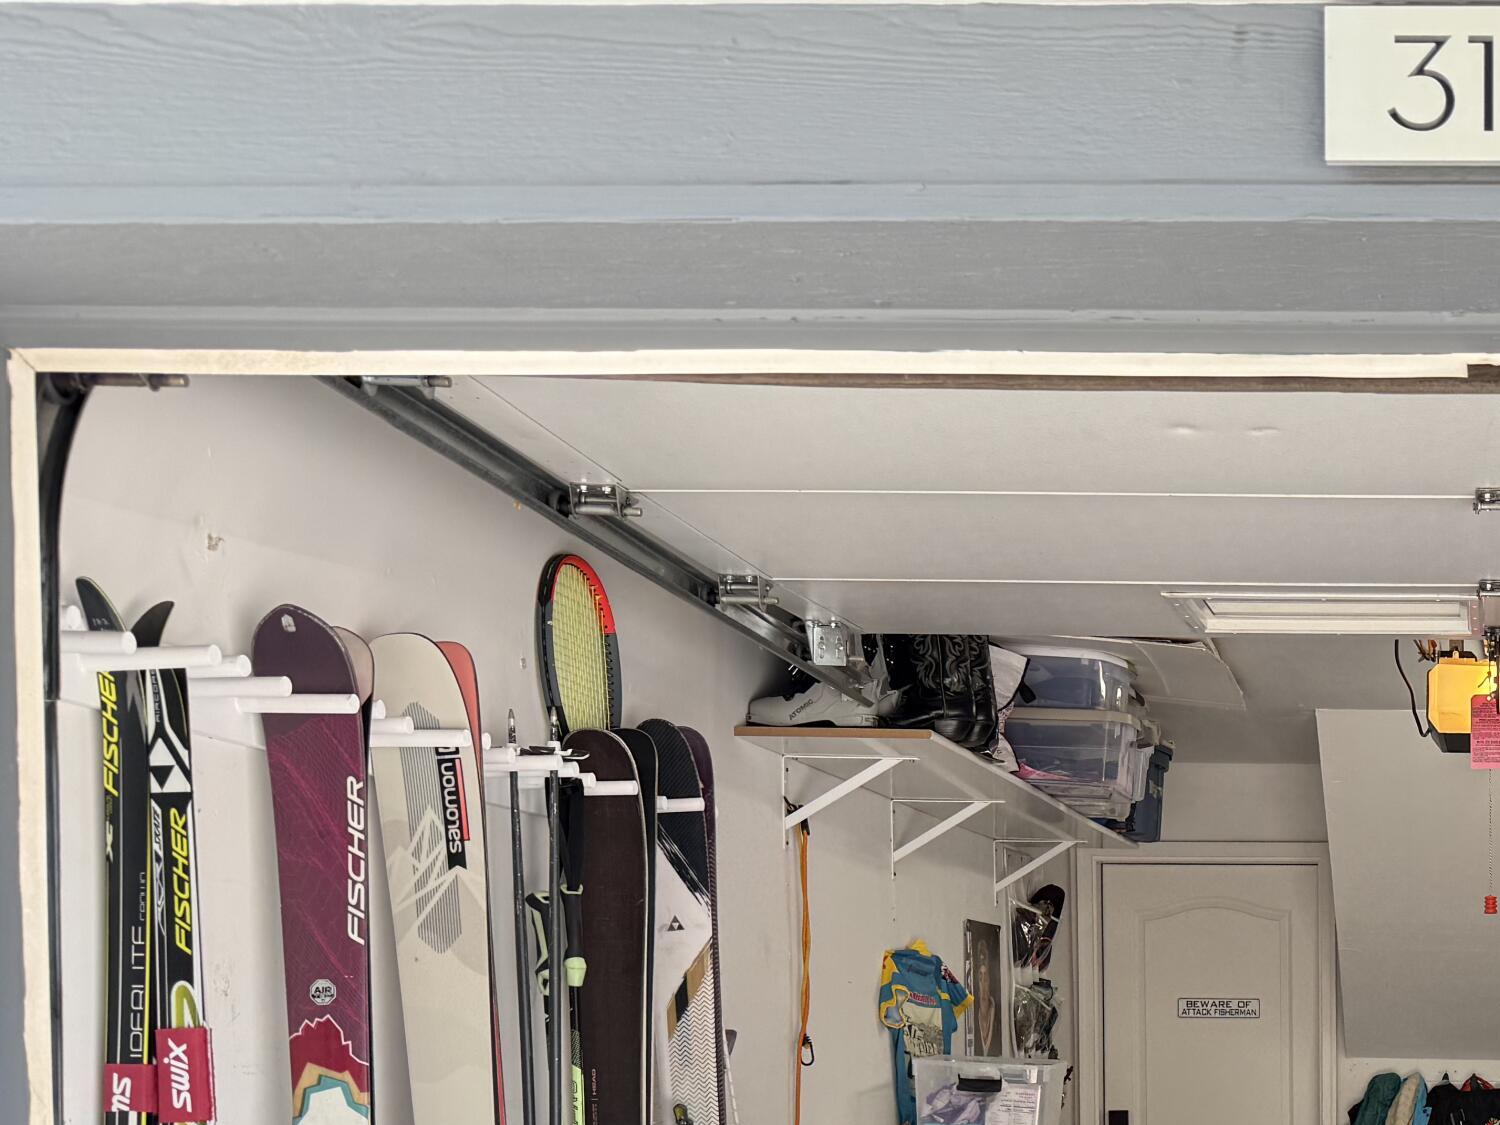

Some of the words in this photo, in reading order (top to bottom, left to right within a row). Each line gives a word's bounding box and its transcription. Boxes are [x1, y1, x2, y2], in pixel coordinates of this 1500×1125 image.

[788, 698, 814, 721] ATOMIC
[346, 775, 365, 946] FISCHER
[169, 807, 194, 956] FISCHER
[314, 984, 333, 995] AIR
[1181, 1008, 1212, 1016] ATTACK
[1214, 1008, 1257, 1016] FISHERMAN
[1186, 1000, 1232, 1008] BEWARE
[1237, 1000, 1252, 1008] OF
